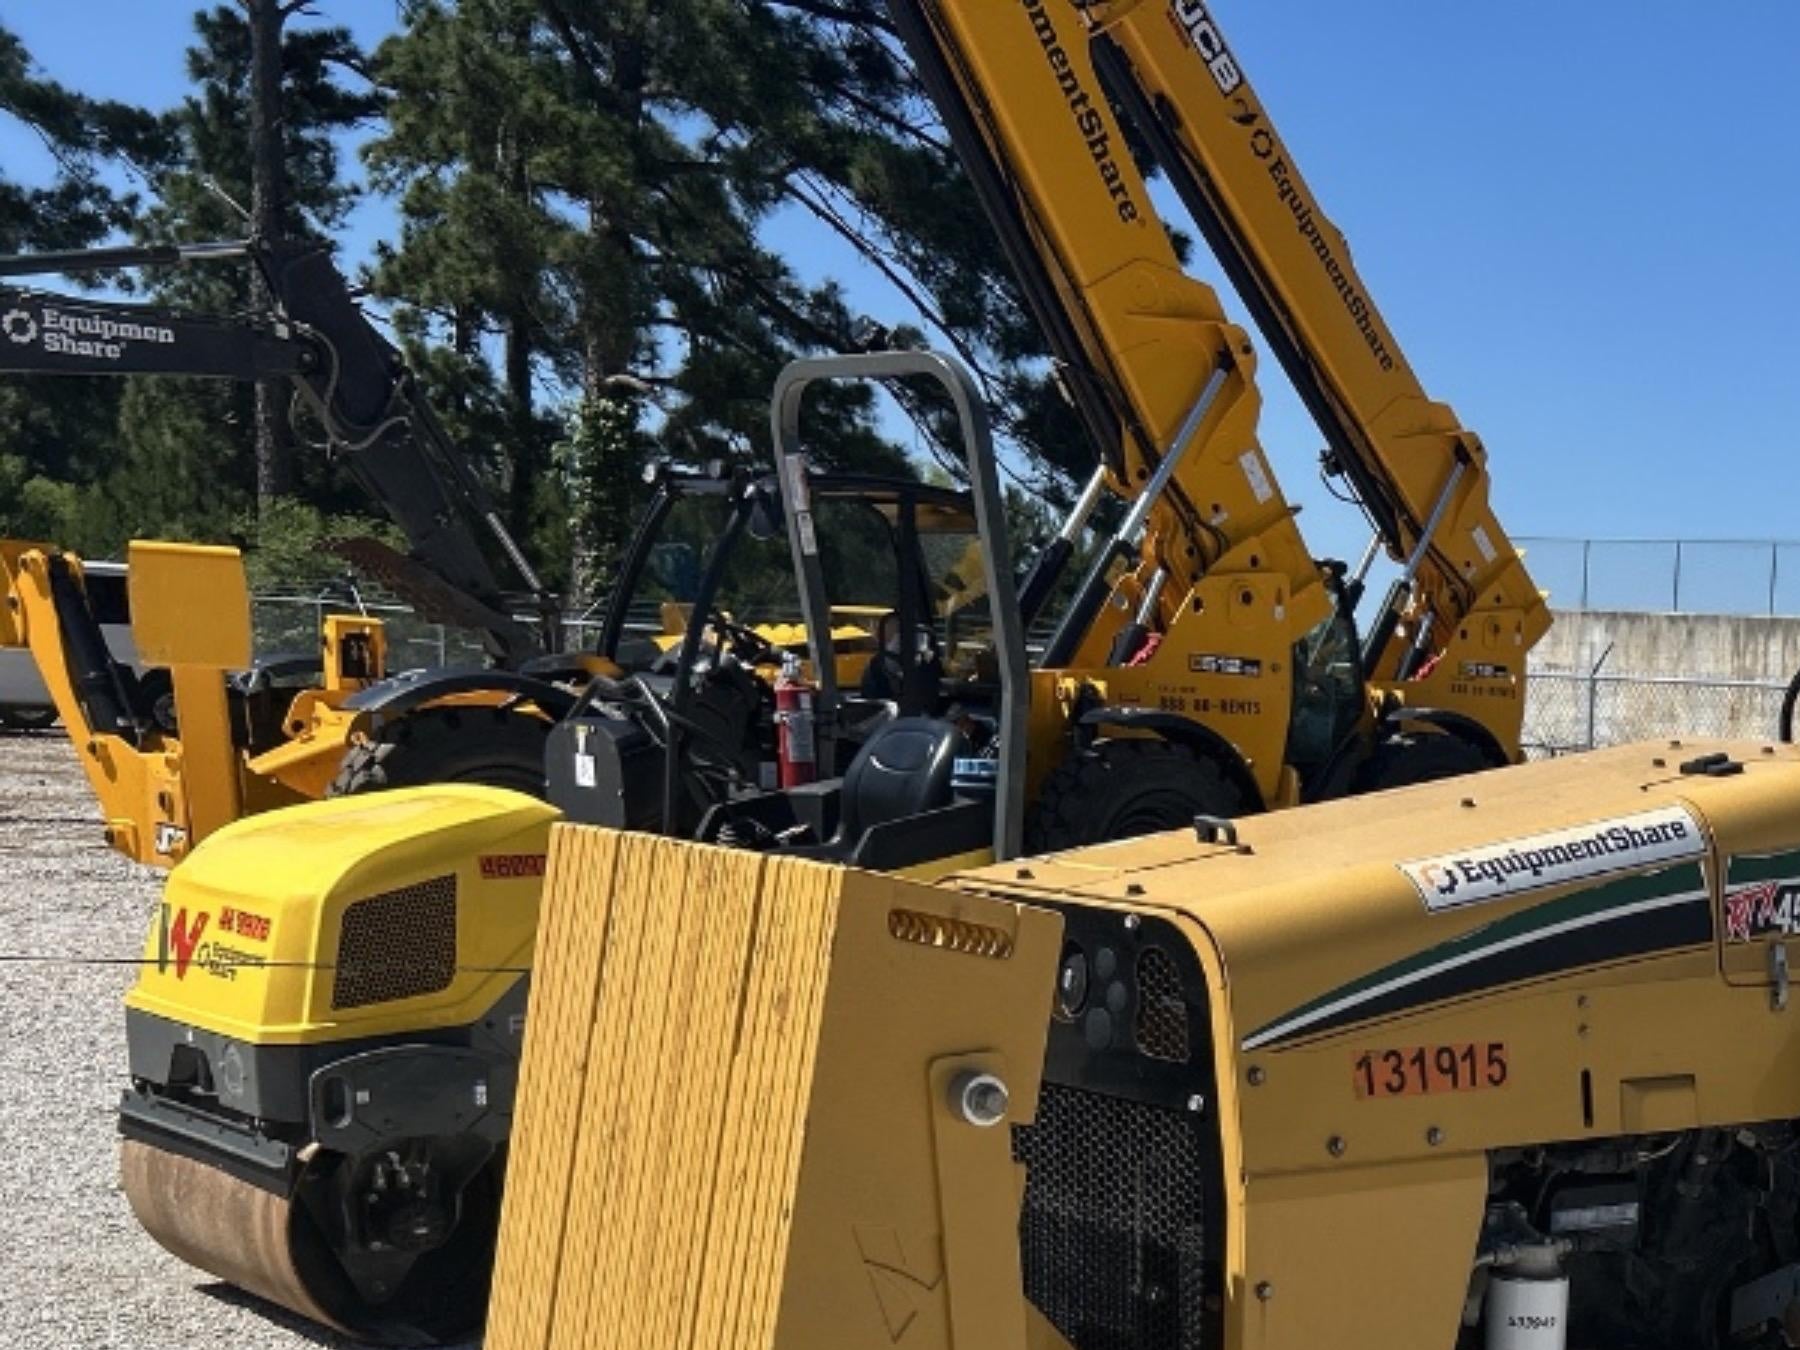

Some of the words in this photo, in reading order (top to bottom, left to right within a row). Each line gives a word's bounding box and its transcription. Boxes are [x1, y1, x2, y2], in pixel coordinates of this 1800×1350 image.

[1175, 0, 1241, 93] JCB
[1024, 0, 1137, 224] mentShare
[1268, 157, 1393, 372] EquipmentShare
[44, 332, 121, 359] Share
[1454, 820, 1688, 884] EquipmentShare
[1356, 1043, 1507, 1096] 131915
